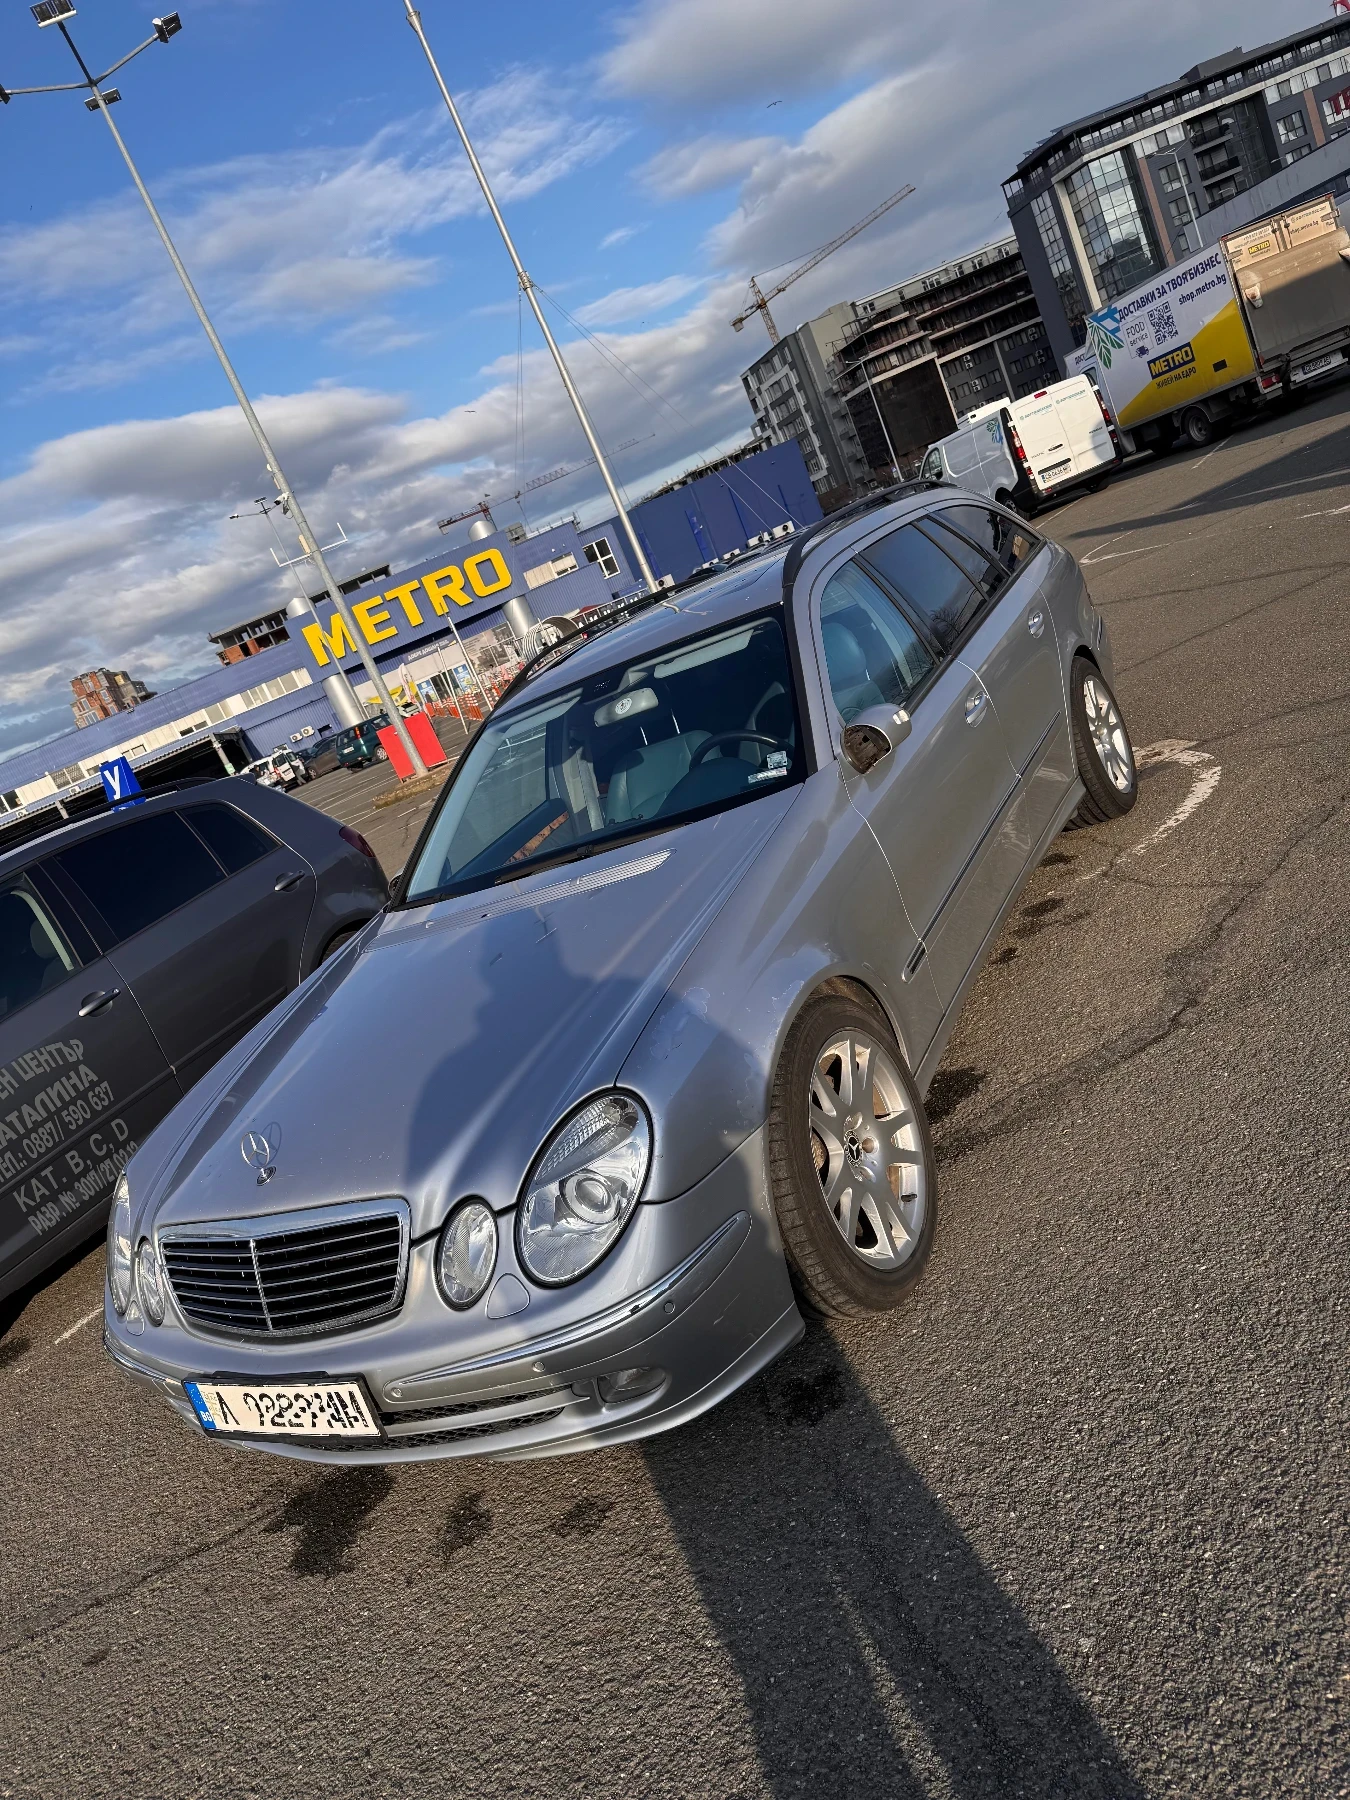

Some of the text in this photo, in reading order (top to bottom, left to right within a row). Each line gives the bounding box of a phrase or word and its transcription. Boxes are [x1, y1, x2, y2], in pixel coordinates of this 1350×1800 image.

[1248, 241, 1270, 254] METRO
[1118, 252, 1222, 321] ДОСТАВКИ ЗА ТВОЯ БИЗНЕС
[1178, 273, 1227, 306] shop.metro.bg
[1125, 321, 1146, 339] FOOD
[1129, 332, 1149, 347] service
[1149, 346, 1193, 376] METRO
[1156, 366, 1197, 389] ЖИВЕЙ НА ЕДРО
[301, 548, 512, 667] METRO
[11, 1039, 84, 1081] ЦЕНТЪР
[0, 1064, 98, 1150] АТАЛИНА
[0, 1081, 114, 1182] ЕЛ.: 0887/ 590 637
[13, 1166, 67, 1212] КАТ.
[110, 1119, 129, 1141] D
[200, 1411, 213, 1422] BG
